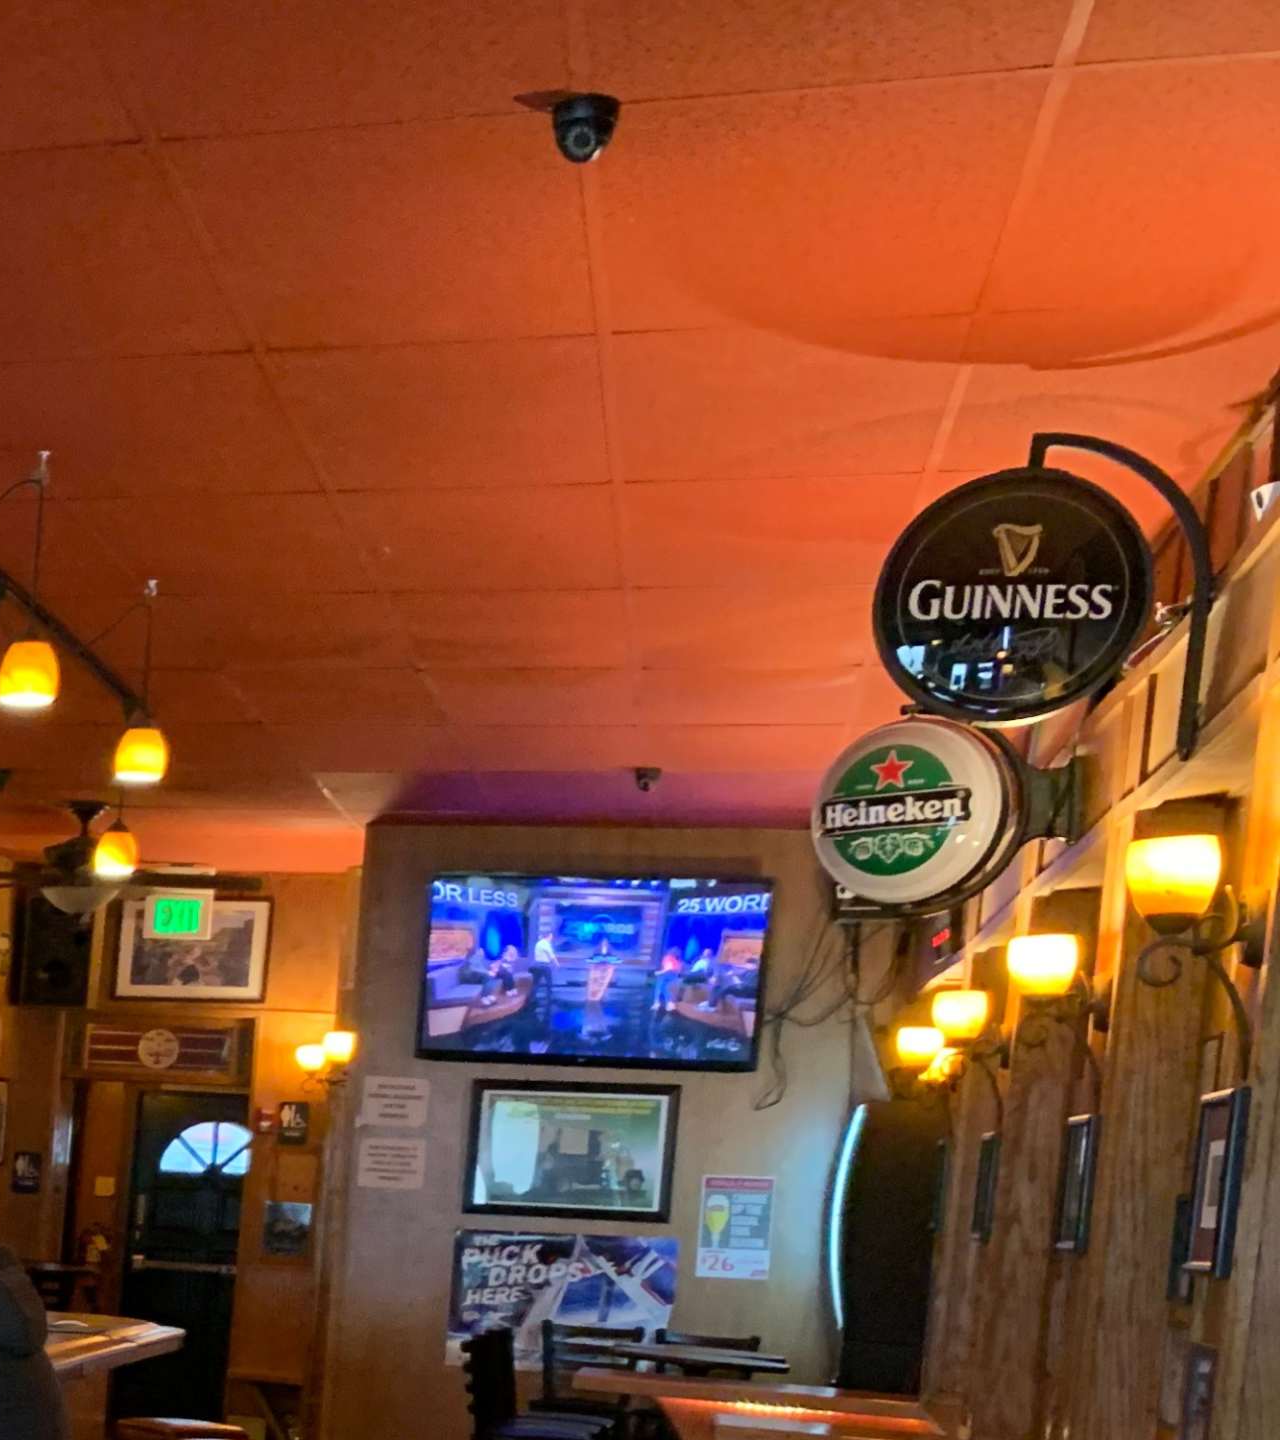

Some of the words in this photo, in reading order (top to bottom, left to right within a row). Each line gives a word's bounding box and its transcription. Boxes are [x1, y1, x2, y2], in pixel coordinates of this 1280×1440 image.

[909, 579, 1114, 622] GUINNESS
[825, 795, 966, 829] Heineken
[468, 889, 519, 908] LESS
[677, 899, 701, 913] 25
[462, 1243, 543, 1270] PUCK
[487, 1262, 586, 1288] DROPS
[462, 1285, 526, 1306] HERE
